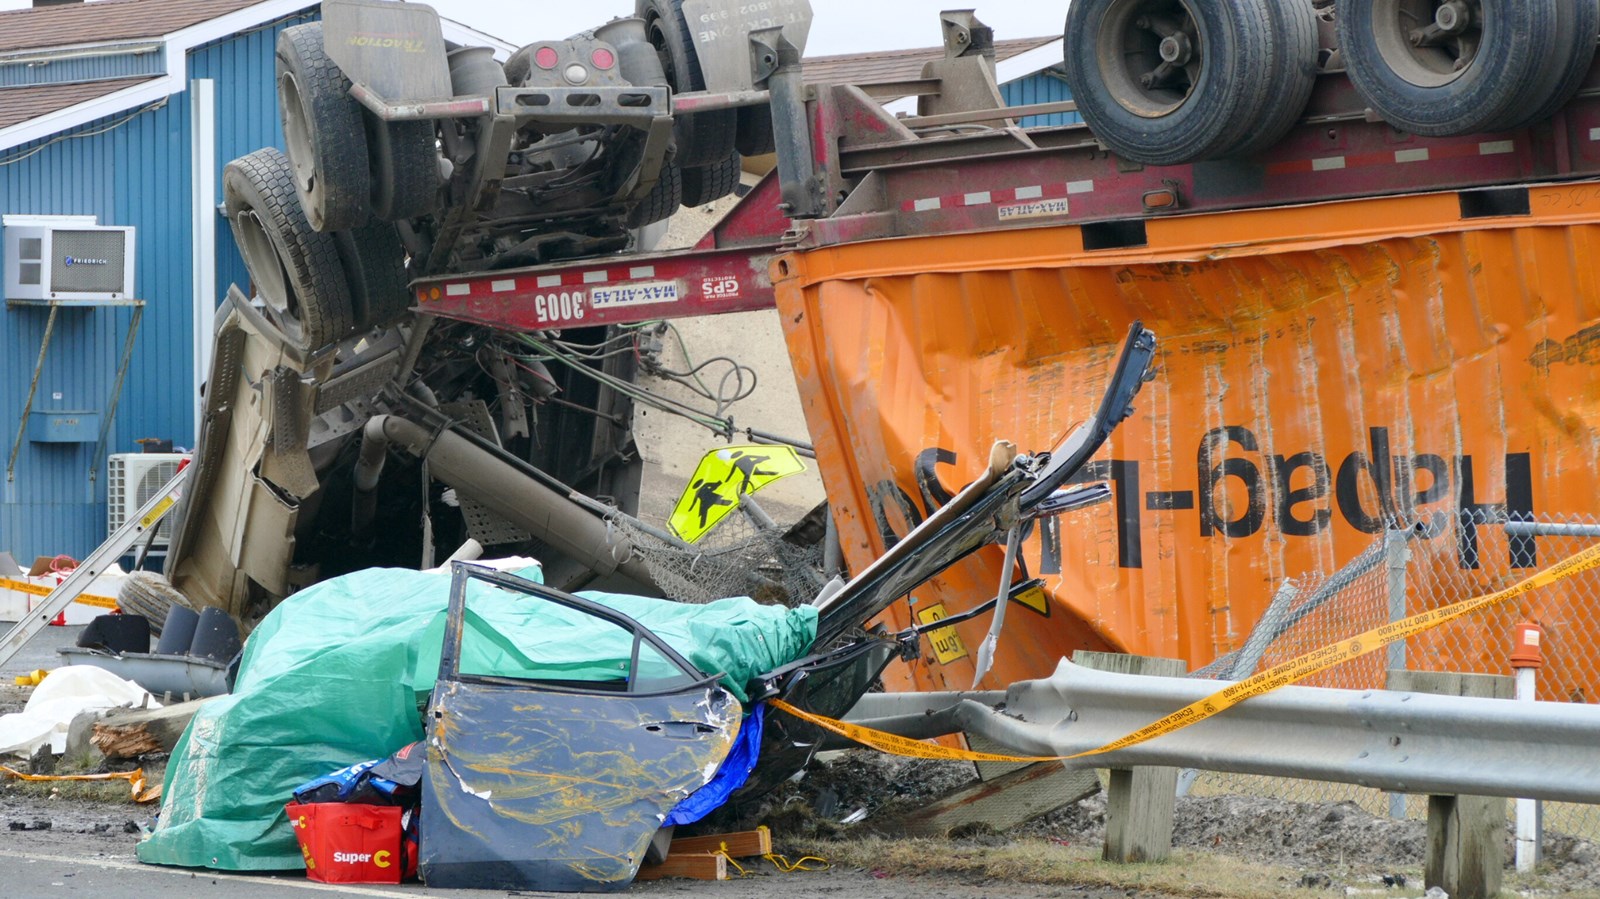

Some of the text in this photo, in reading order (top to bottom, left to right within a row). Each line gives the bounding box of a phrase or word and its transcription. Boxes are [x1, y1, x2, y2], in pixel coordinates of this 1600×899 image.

[1000, 201, 1067, 217] MAX-ATLAS
[593, 282, 676, 304] MAX-ATLAS
[702, 280, 739, 295] GPS
[534, 291, 584, 323] 3005
[1272, 661, 1297, 676] CRIME
[1292, 660, 1323, 679] INTERDIT
[1297, 656, 1309, 666] AU
[1252, 673, 1266, 685] 800
[1222, 679, 1252, 699] 711-1800
[333, 851, 371, 864] Super
[373, 850, 391, 868] C
